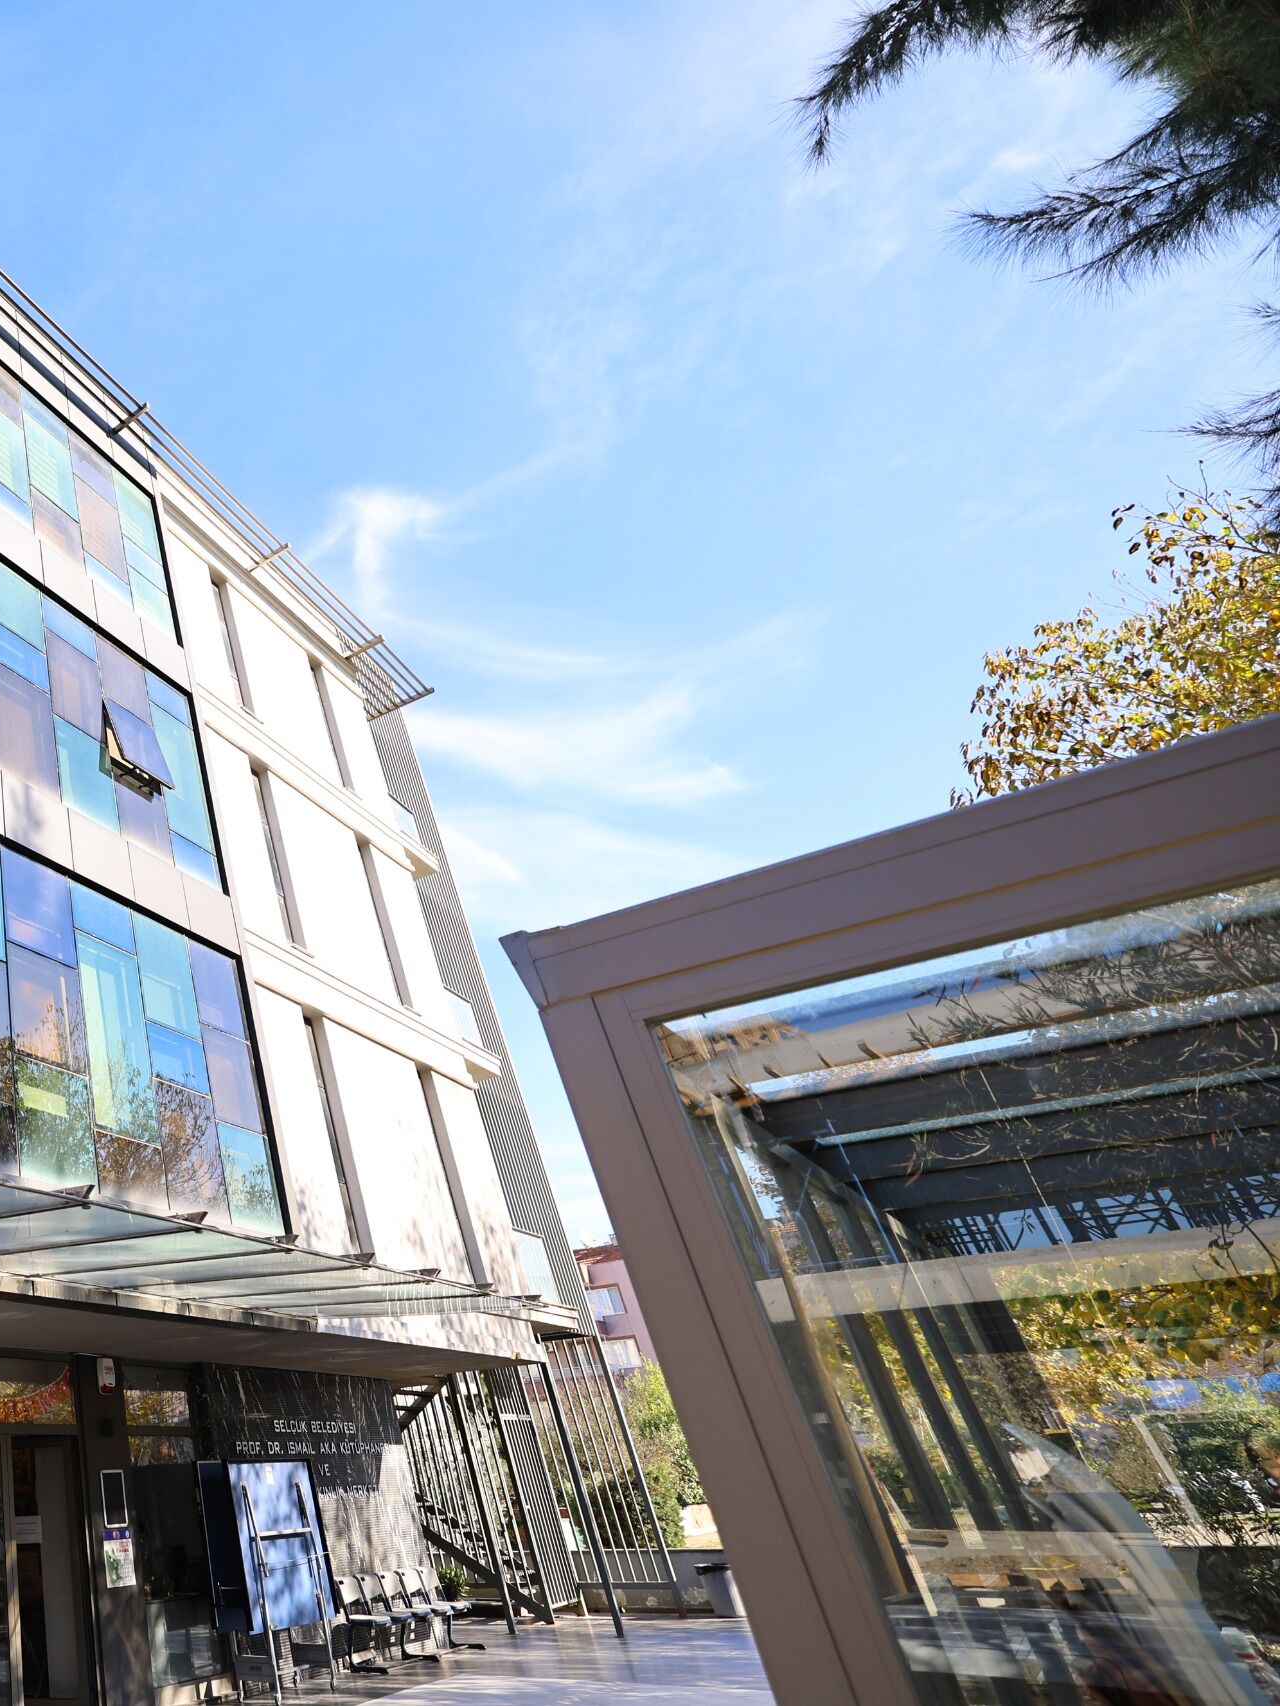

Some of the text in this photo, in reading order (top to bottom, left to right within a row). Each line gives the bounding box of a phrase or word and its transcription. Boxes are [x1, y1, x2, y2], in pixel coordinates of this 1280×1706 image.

[274, 1420, 308, 1434] SELÇUK
[236, 1441, 264, 1455] PROF.
[267, 1441, 284, 1455] DR.
[320, 1442, 338, 1455] AKA
[318, 1463, 331, 1477] VE
